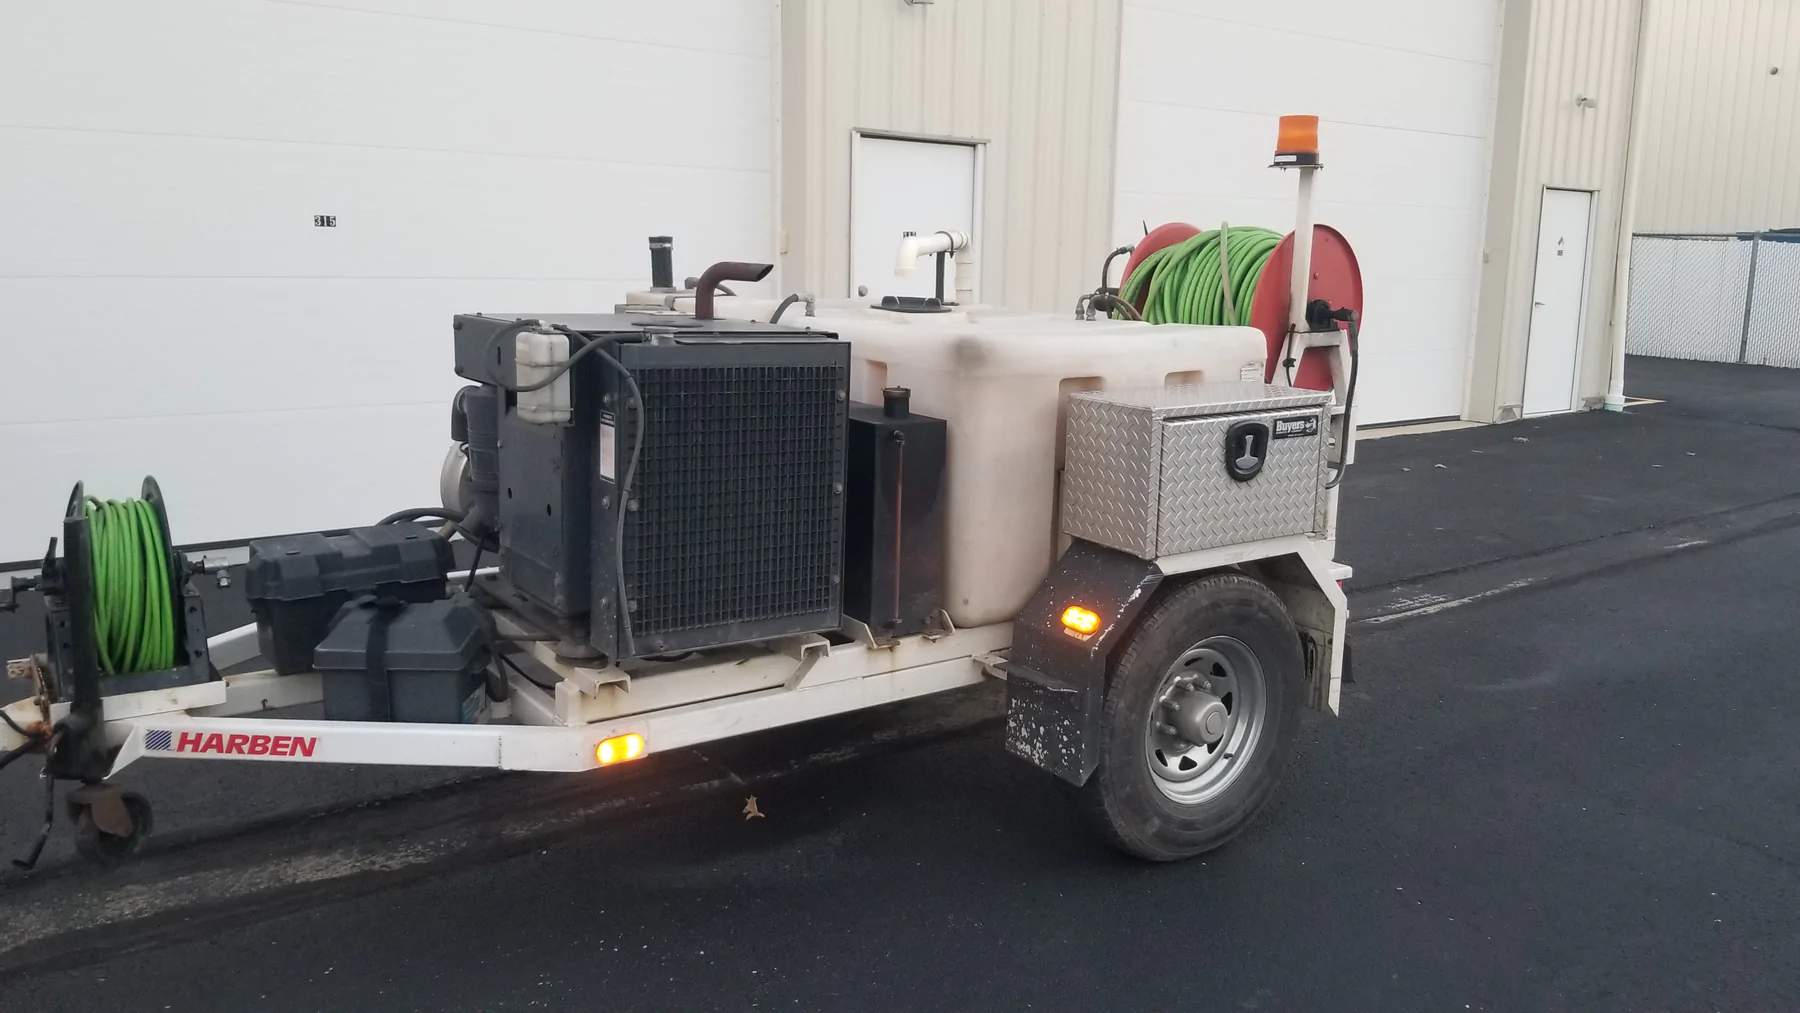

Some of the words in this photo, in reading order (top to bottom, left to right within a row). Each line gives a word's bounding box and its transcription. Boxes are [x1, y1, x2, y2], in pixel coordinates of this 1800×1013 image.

[314, 215, 336, 227] 315
[1276, 420, 1305, 433] Buyers
[176, 732, 317, 757] HARBEN
